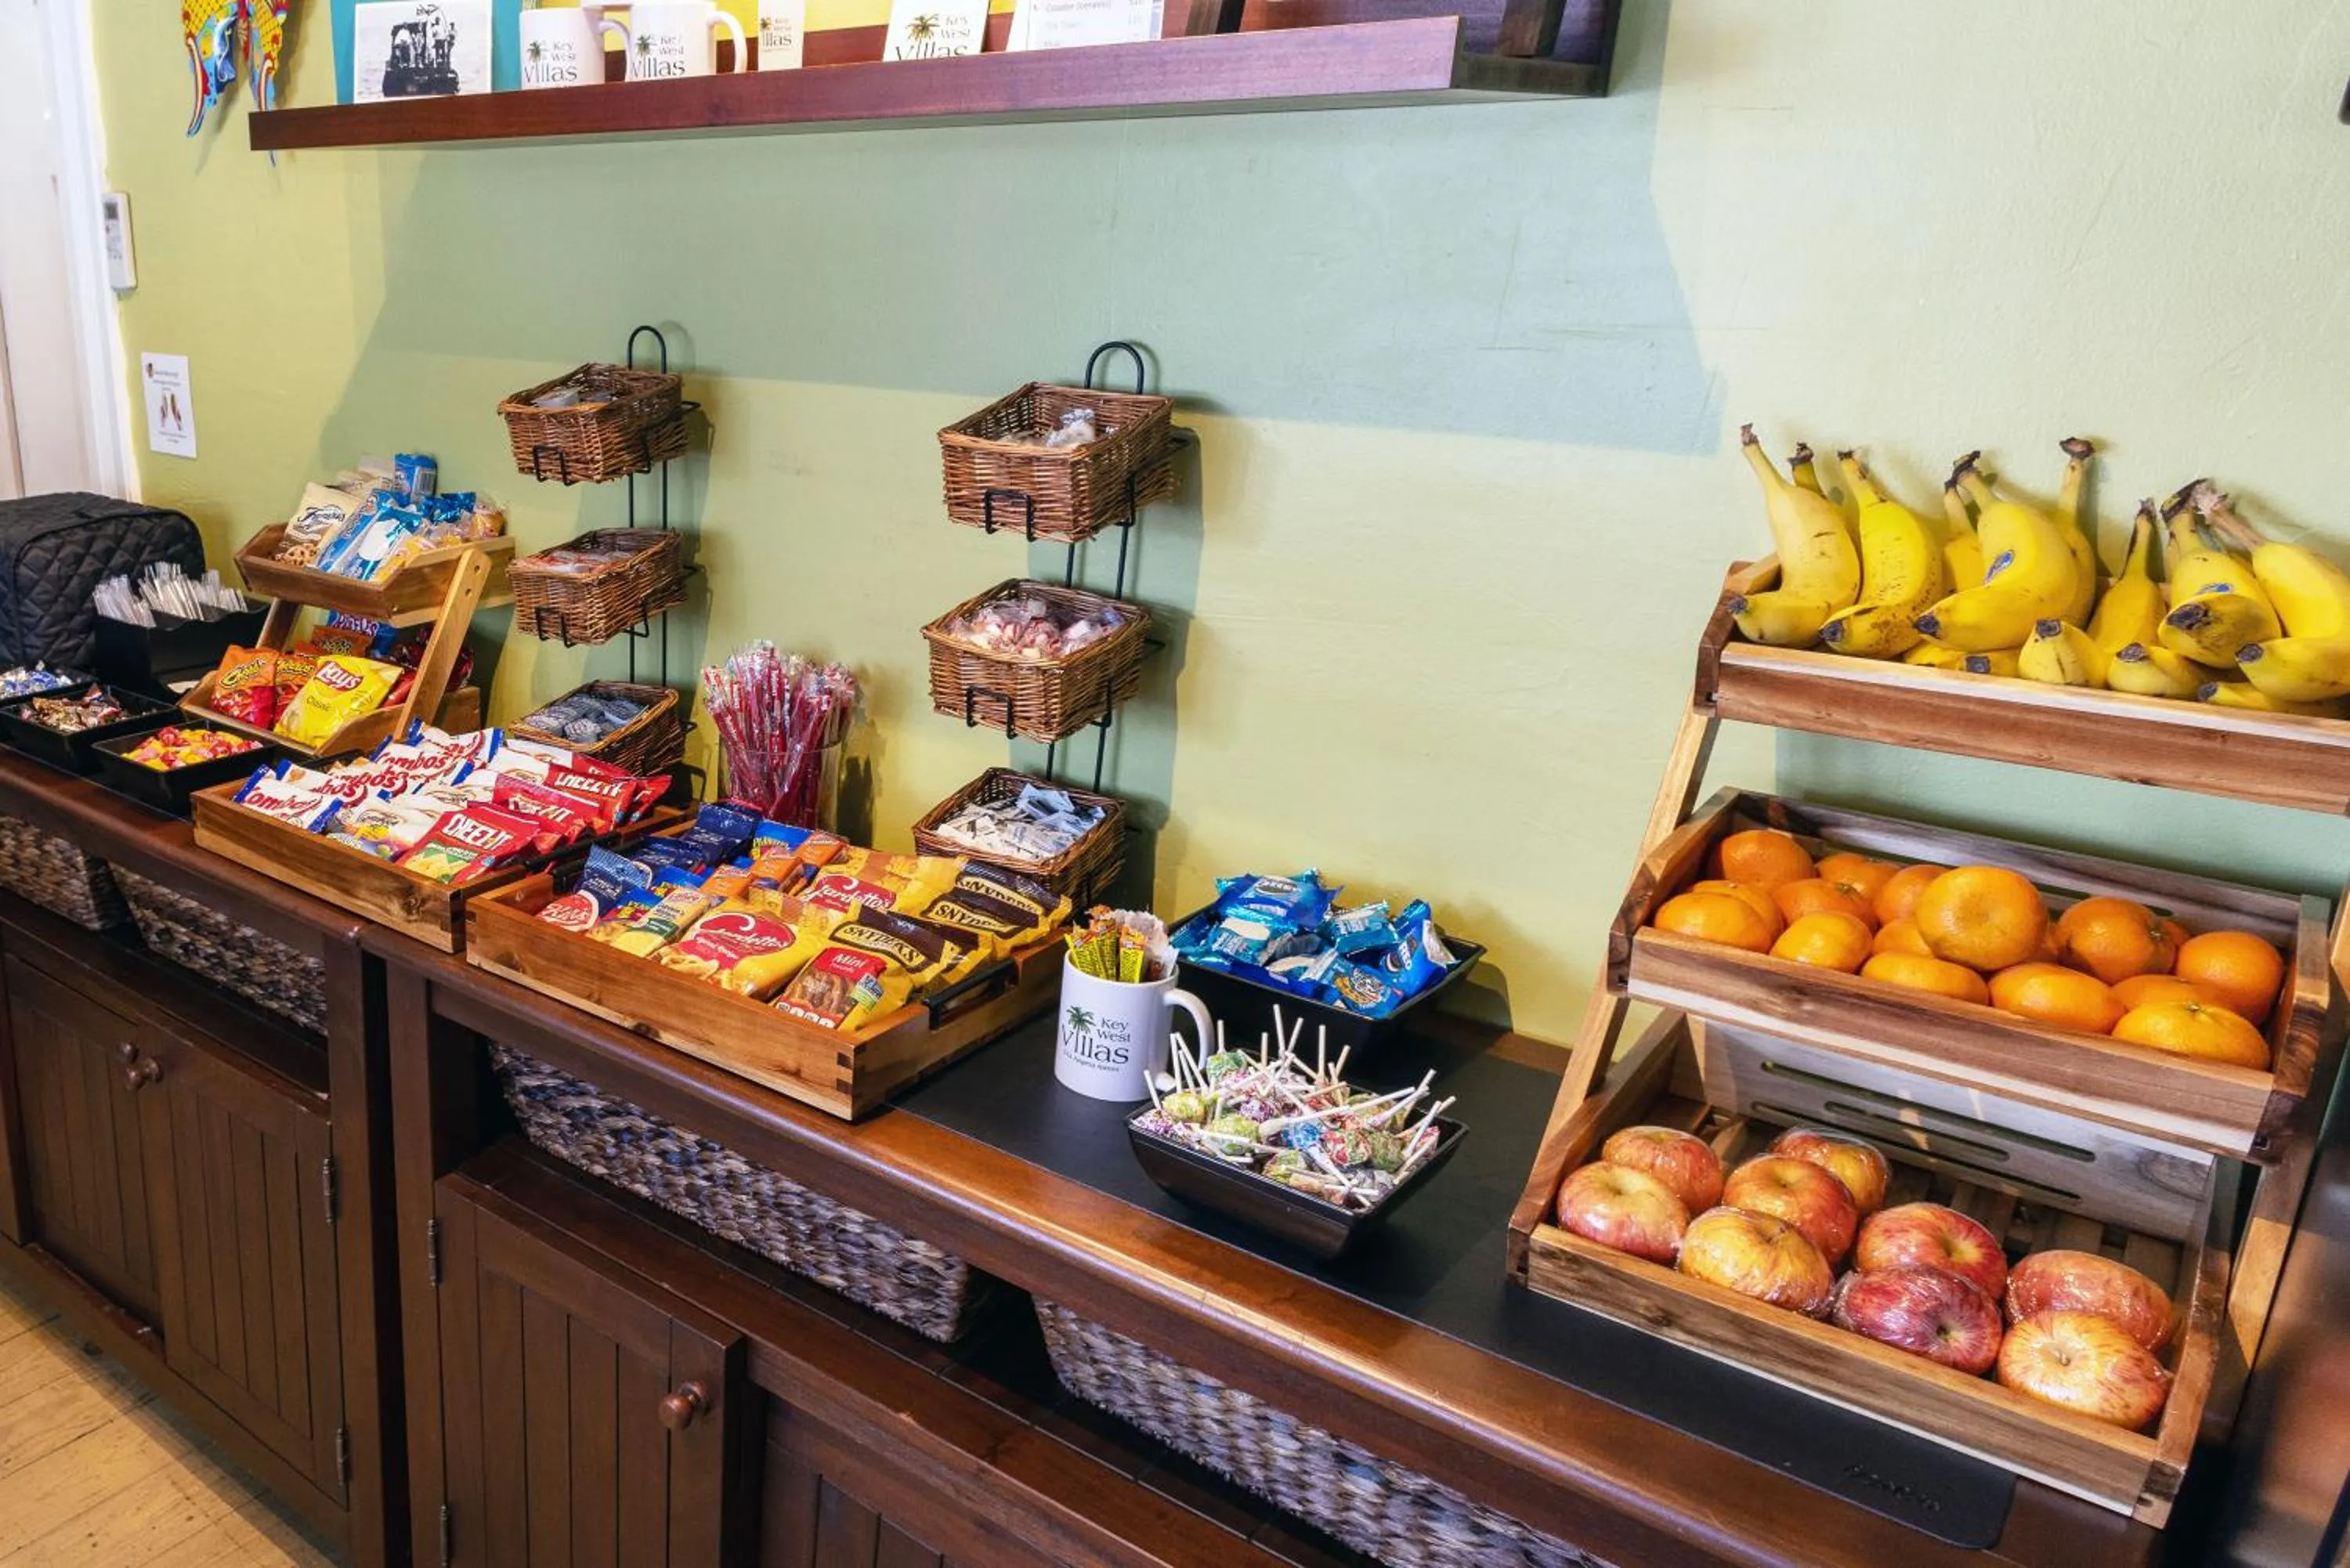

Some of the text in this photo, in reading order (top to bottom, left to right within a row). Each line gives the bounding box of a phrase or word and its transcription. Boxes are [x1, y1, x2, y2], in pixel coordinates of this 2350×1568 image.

[523, 61, 578, 84] Villas
[631, 57, 685, 78] Villas
[832, 953, 866, 969] Mini
[1100, 1017, 1130, 1031] Key
[1061, 1023, 1130, 1064] Villas
[1097, 1028, 1130, 1043] West
